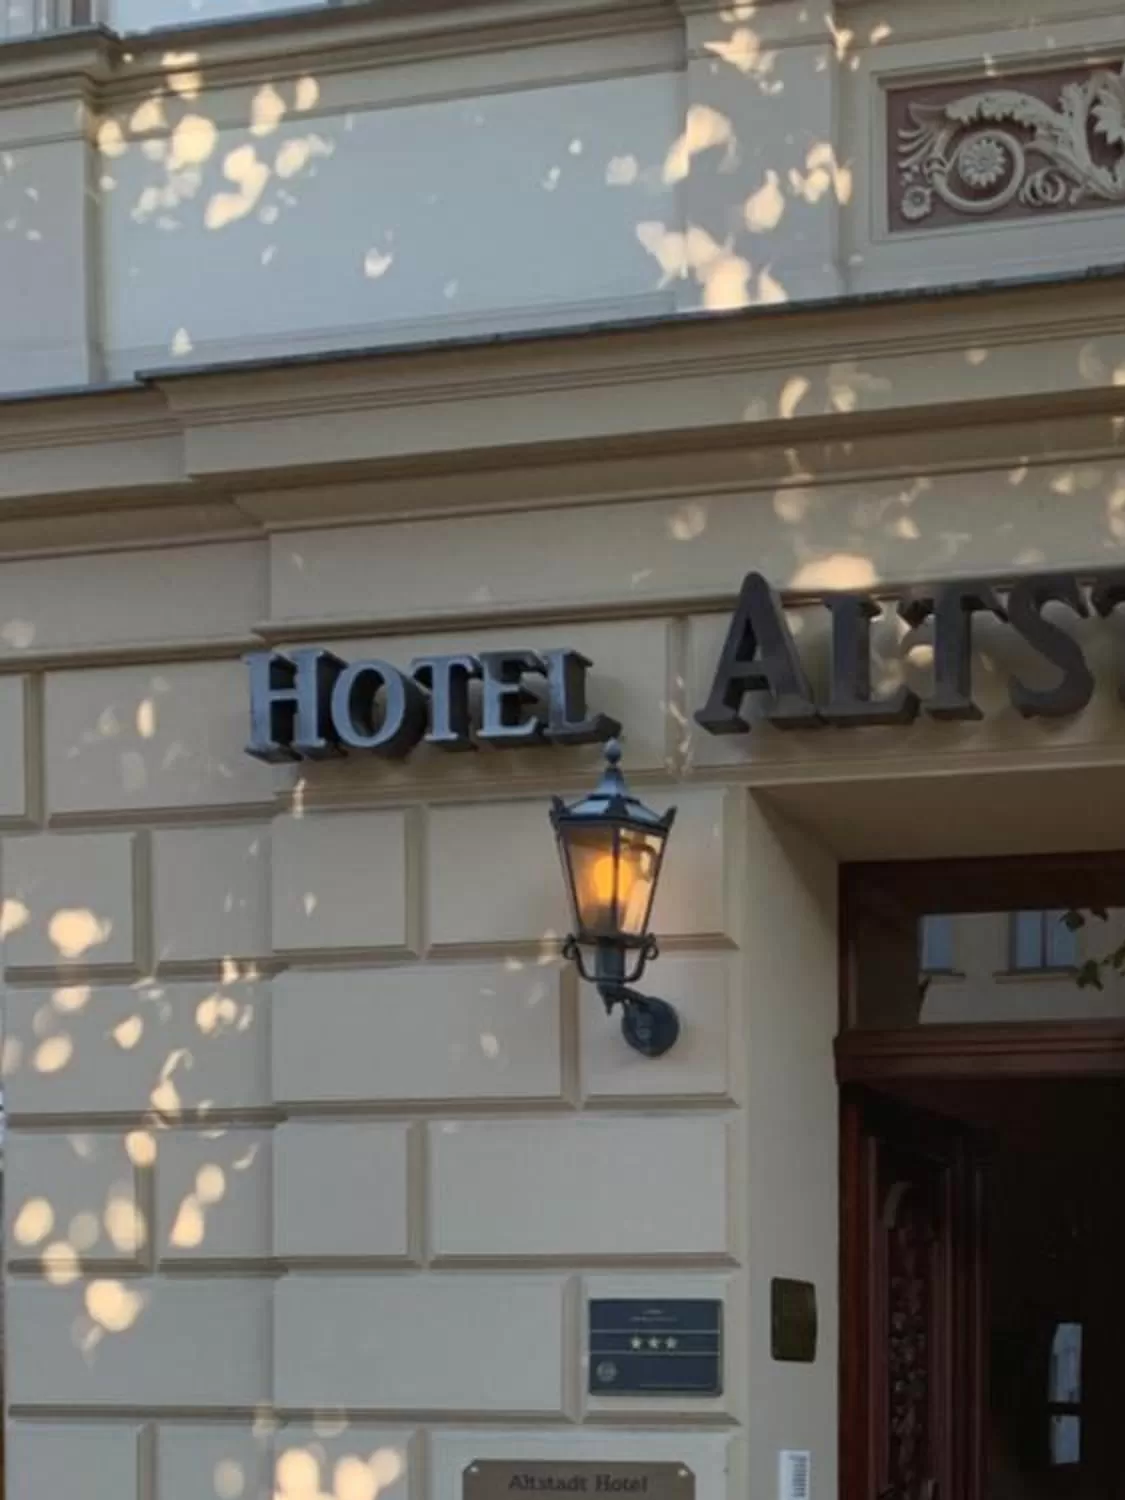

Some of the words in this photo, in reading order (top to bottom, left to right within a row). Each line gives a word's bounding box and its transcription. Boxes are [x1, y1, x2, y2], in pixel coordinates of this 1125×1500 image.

[243, 647, 622, 763] HOTEL
[508, 1473, 589, 1493] Altstadt
[594, 1473, 649, 1494] Hotel
